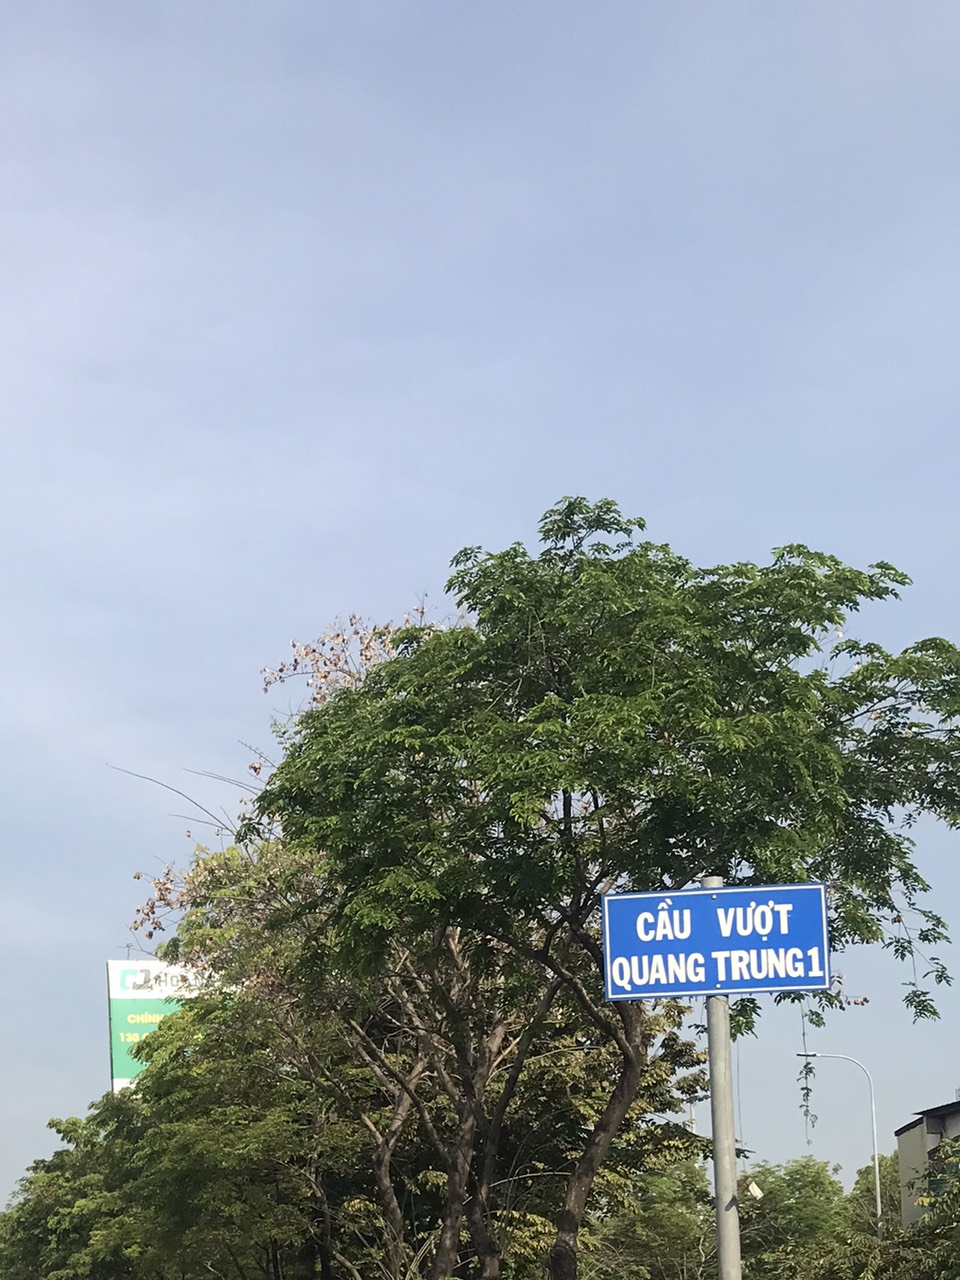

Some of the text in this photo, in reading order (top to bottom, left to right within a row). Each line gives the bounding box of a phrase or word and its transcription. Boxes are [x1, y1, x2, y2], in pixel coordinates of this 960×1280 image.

[636, 899, 793, 942] CẦU VƯỢT
[612, 951, 706, 991] QUANG
